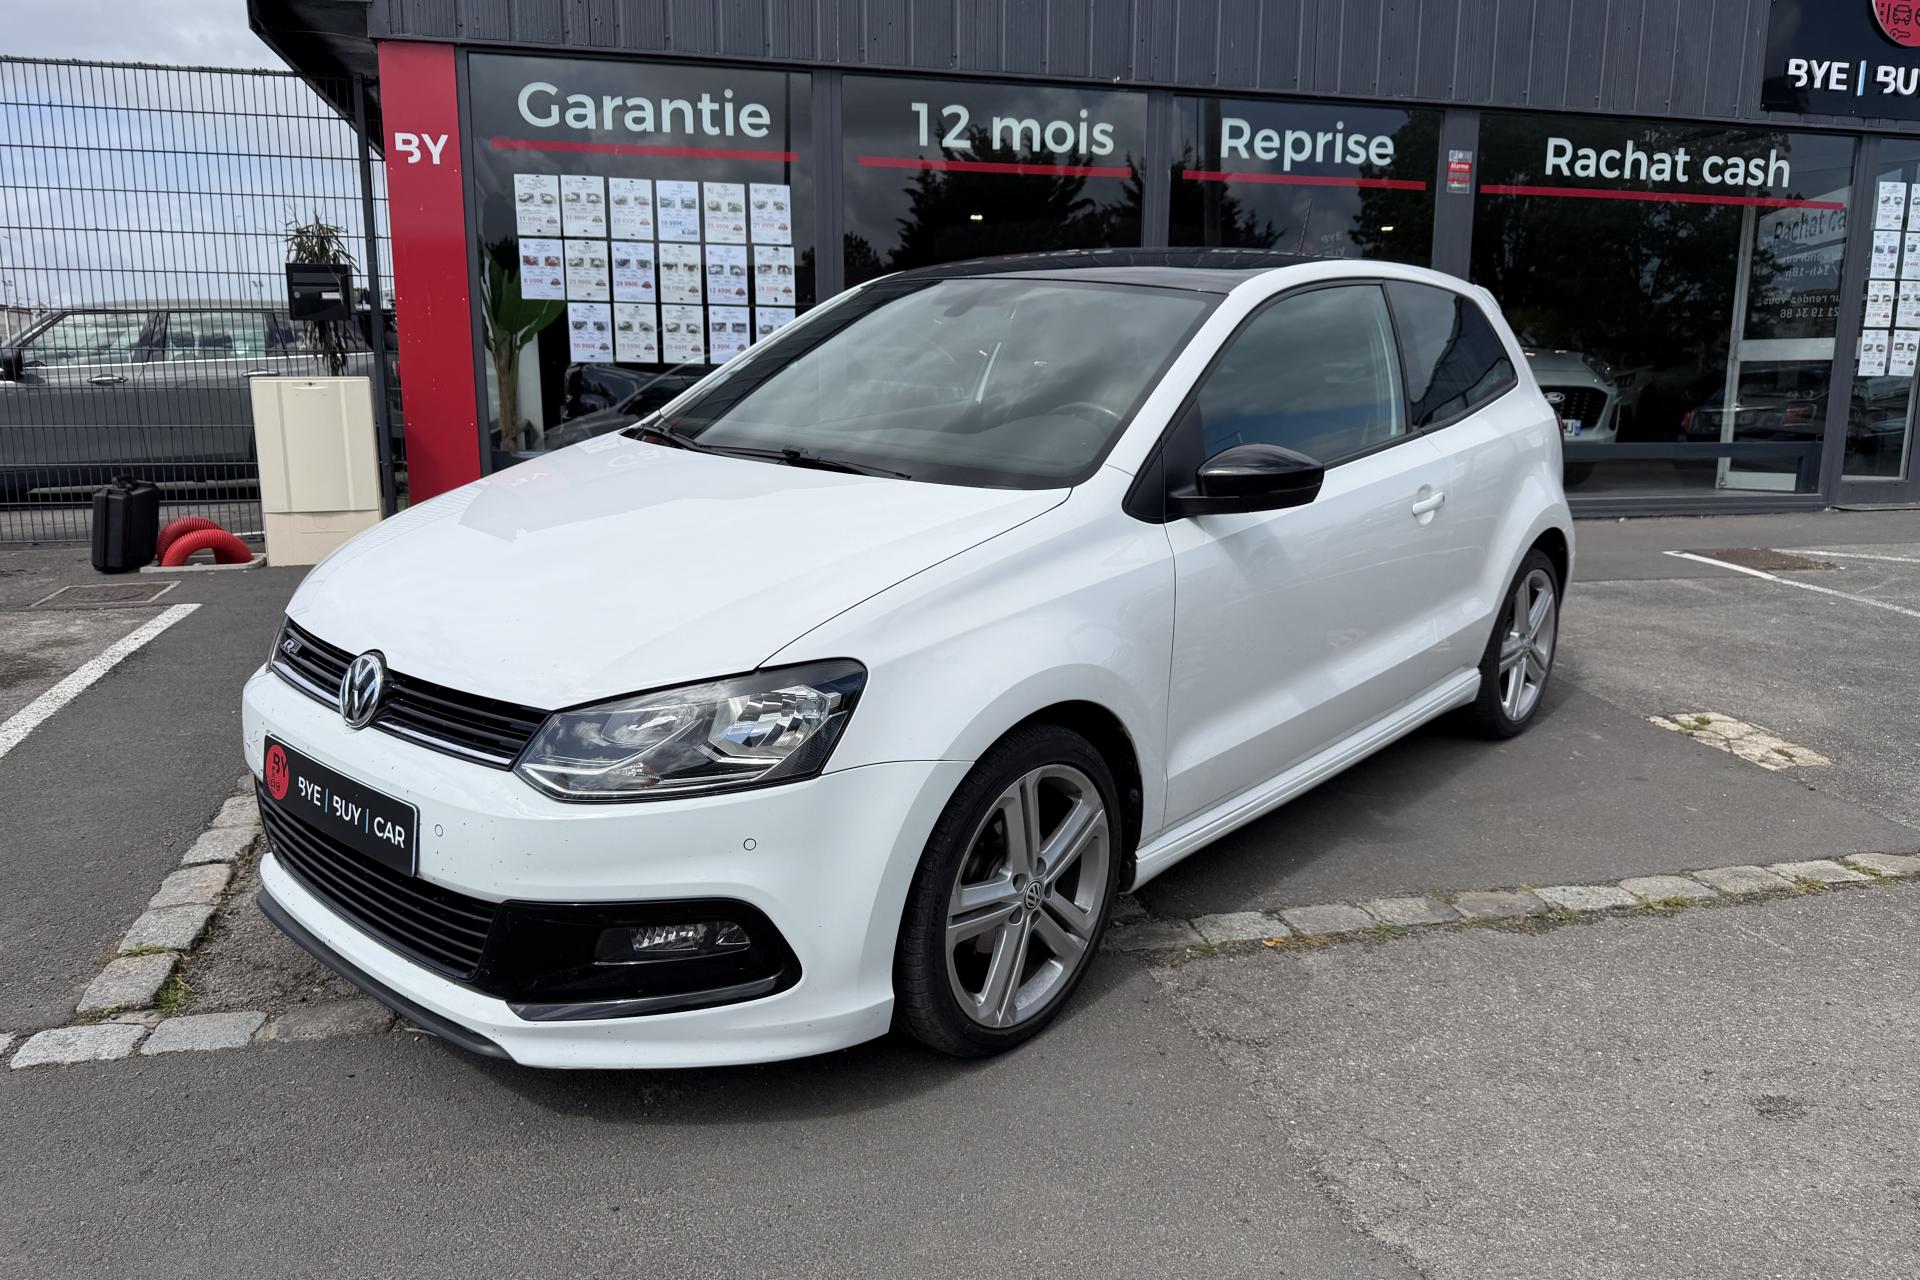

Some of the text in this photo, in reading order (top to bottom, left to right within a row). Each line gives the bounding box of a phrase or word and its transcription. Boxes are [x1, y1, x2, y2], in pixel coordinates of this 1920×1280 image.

[1787, 58, 1920, 95] BYE BU
[517, 81, 771, 138] Garantie
[911, 102, 1114, 155] 12 mois
[394, 132, 449, 165] BY
[1220, 117, 1395, 171] Reprise
[1544, 137, 1790, 188] Rachat cash
[273, 752, 289, 778] BY
[298, 776, 405, 848] BYE BUY CAR
